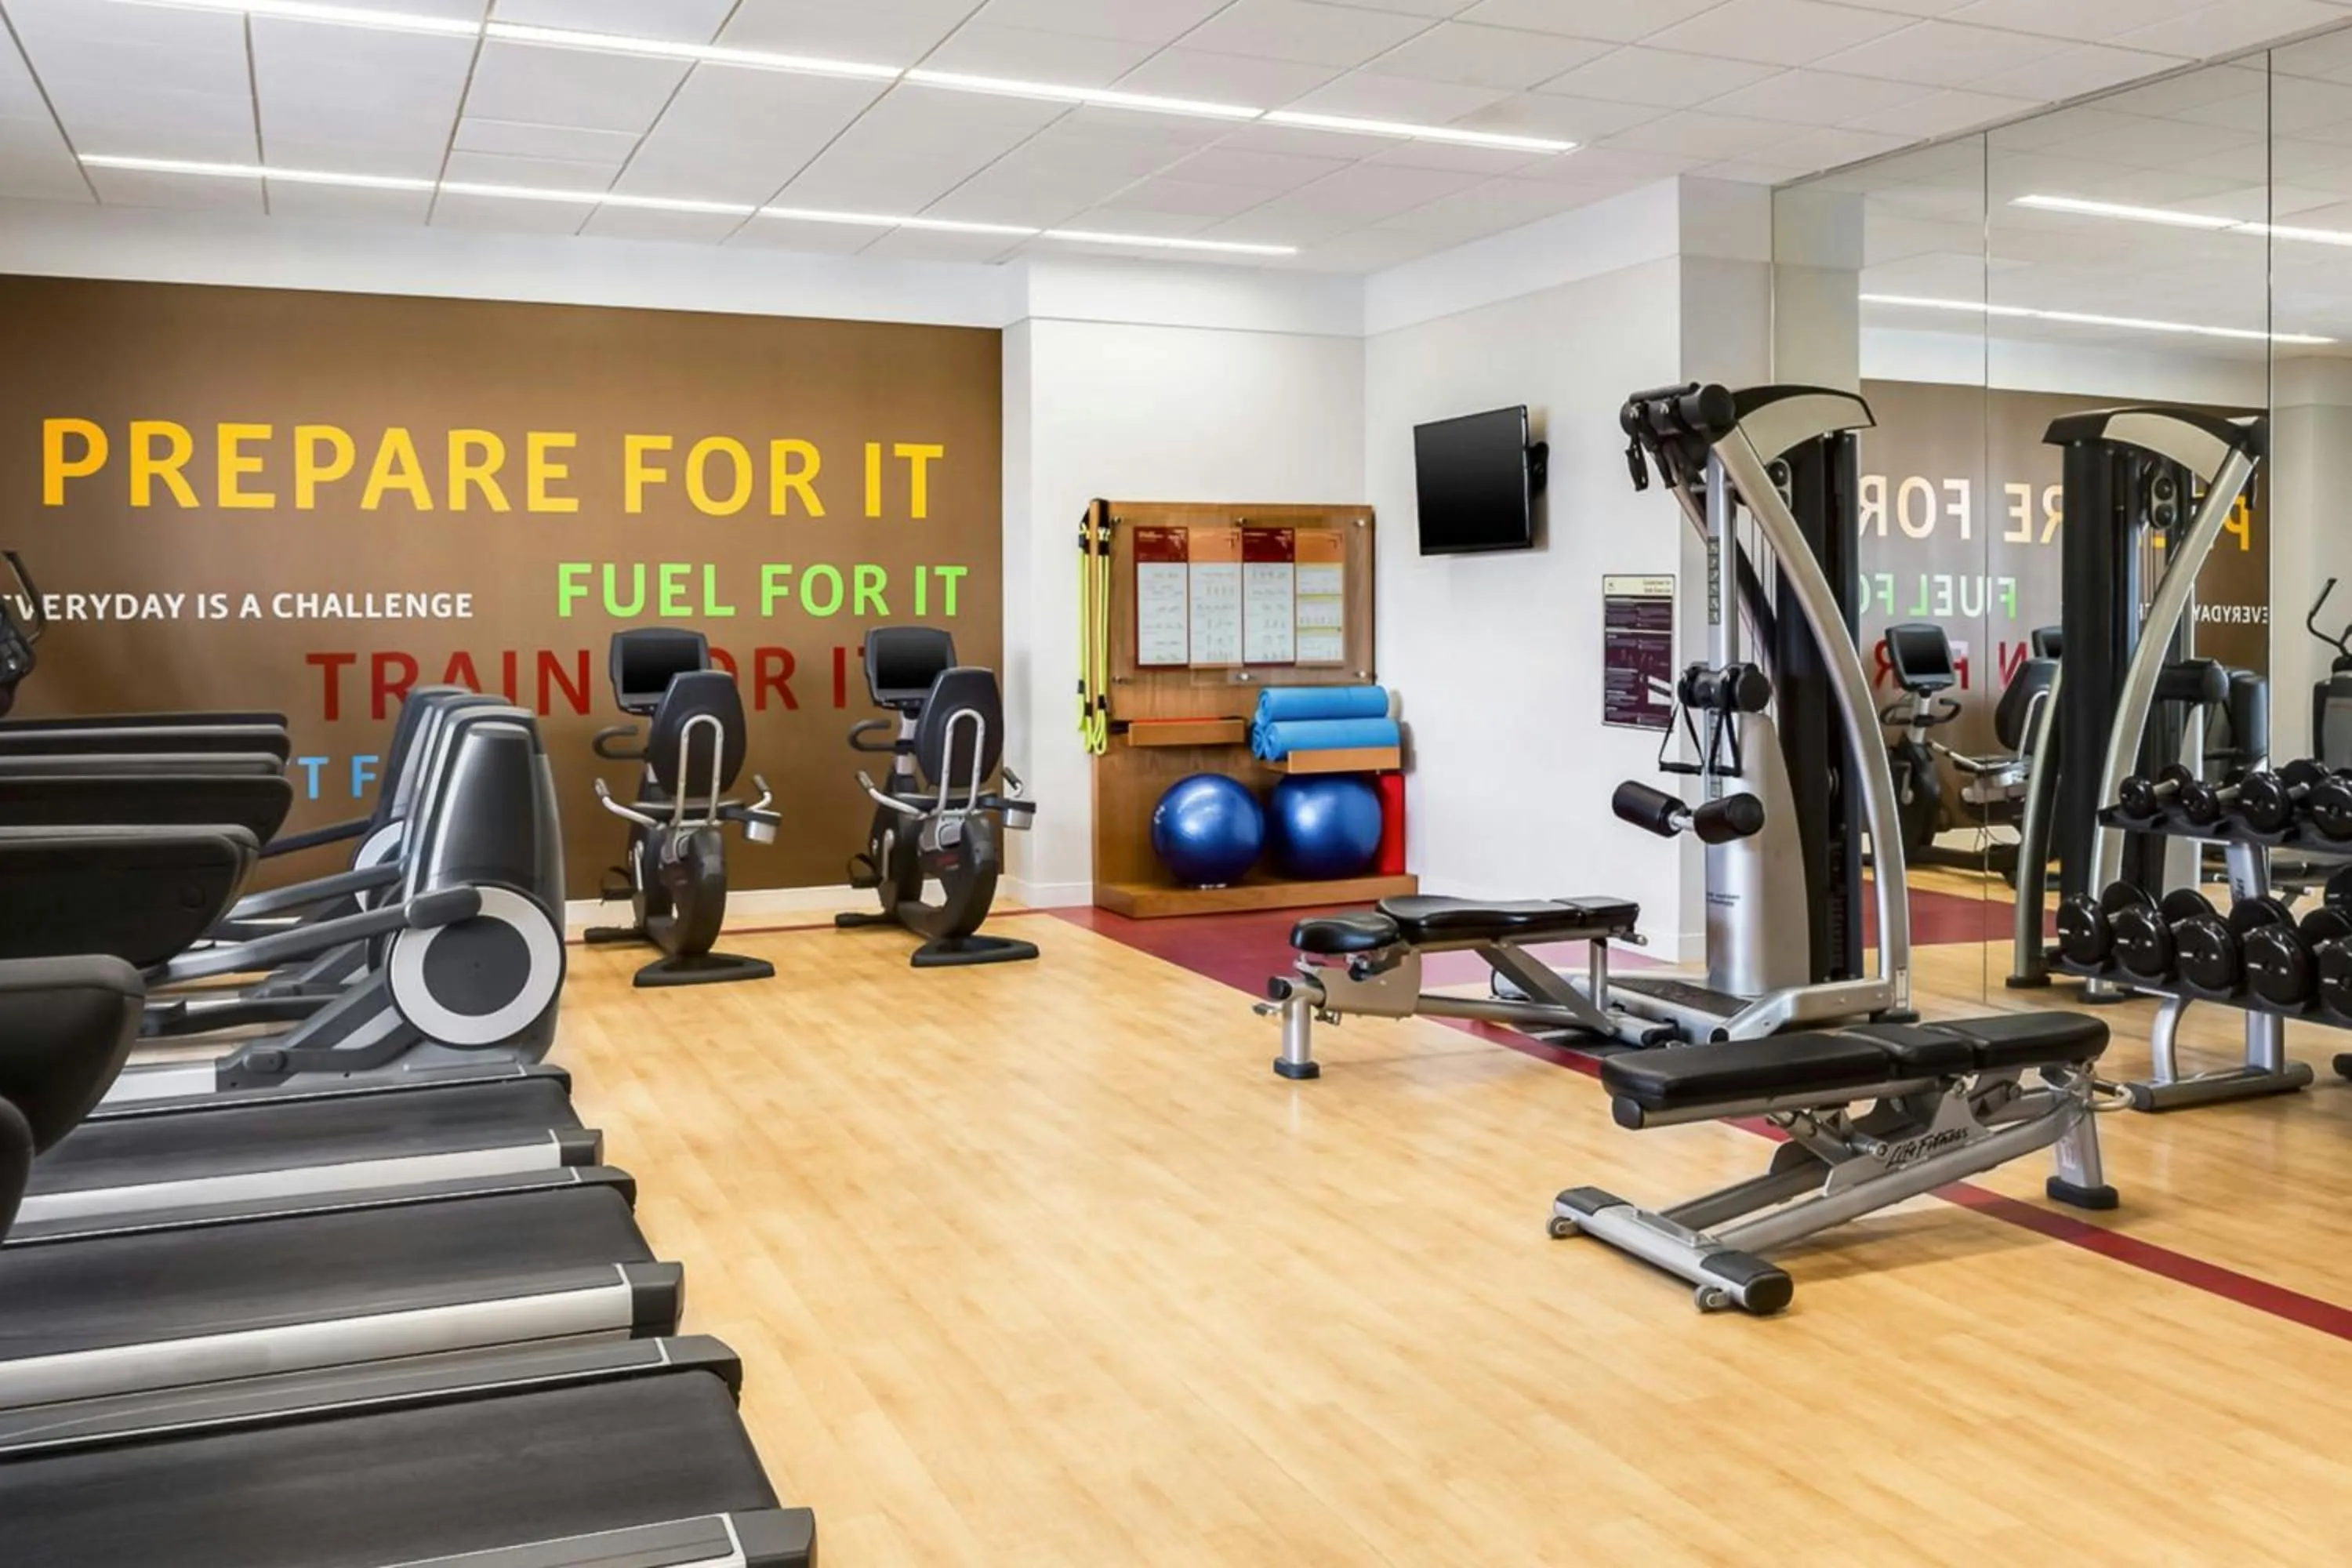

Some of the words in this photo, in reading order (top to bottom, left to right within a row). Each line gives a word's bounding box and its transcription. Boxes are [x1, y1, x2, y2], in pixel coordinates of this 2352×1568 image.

[43, 418, 579, 513] PREPARE
[625, 434, 826, 517] FOR
[865, 442, 944, 518] IT
[3, 593, 185, 620] VERYDAY
[198, 593, 229, 619] IS
[238, 593, 263, 619] A
[272, 592, 474, 619] CHALLENGE
[558, 562, 735, 618] FUEL
[760, 564, 890, 616] FOR
[915, 565, 968, 616] IT
